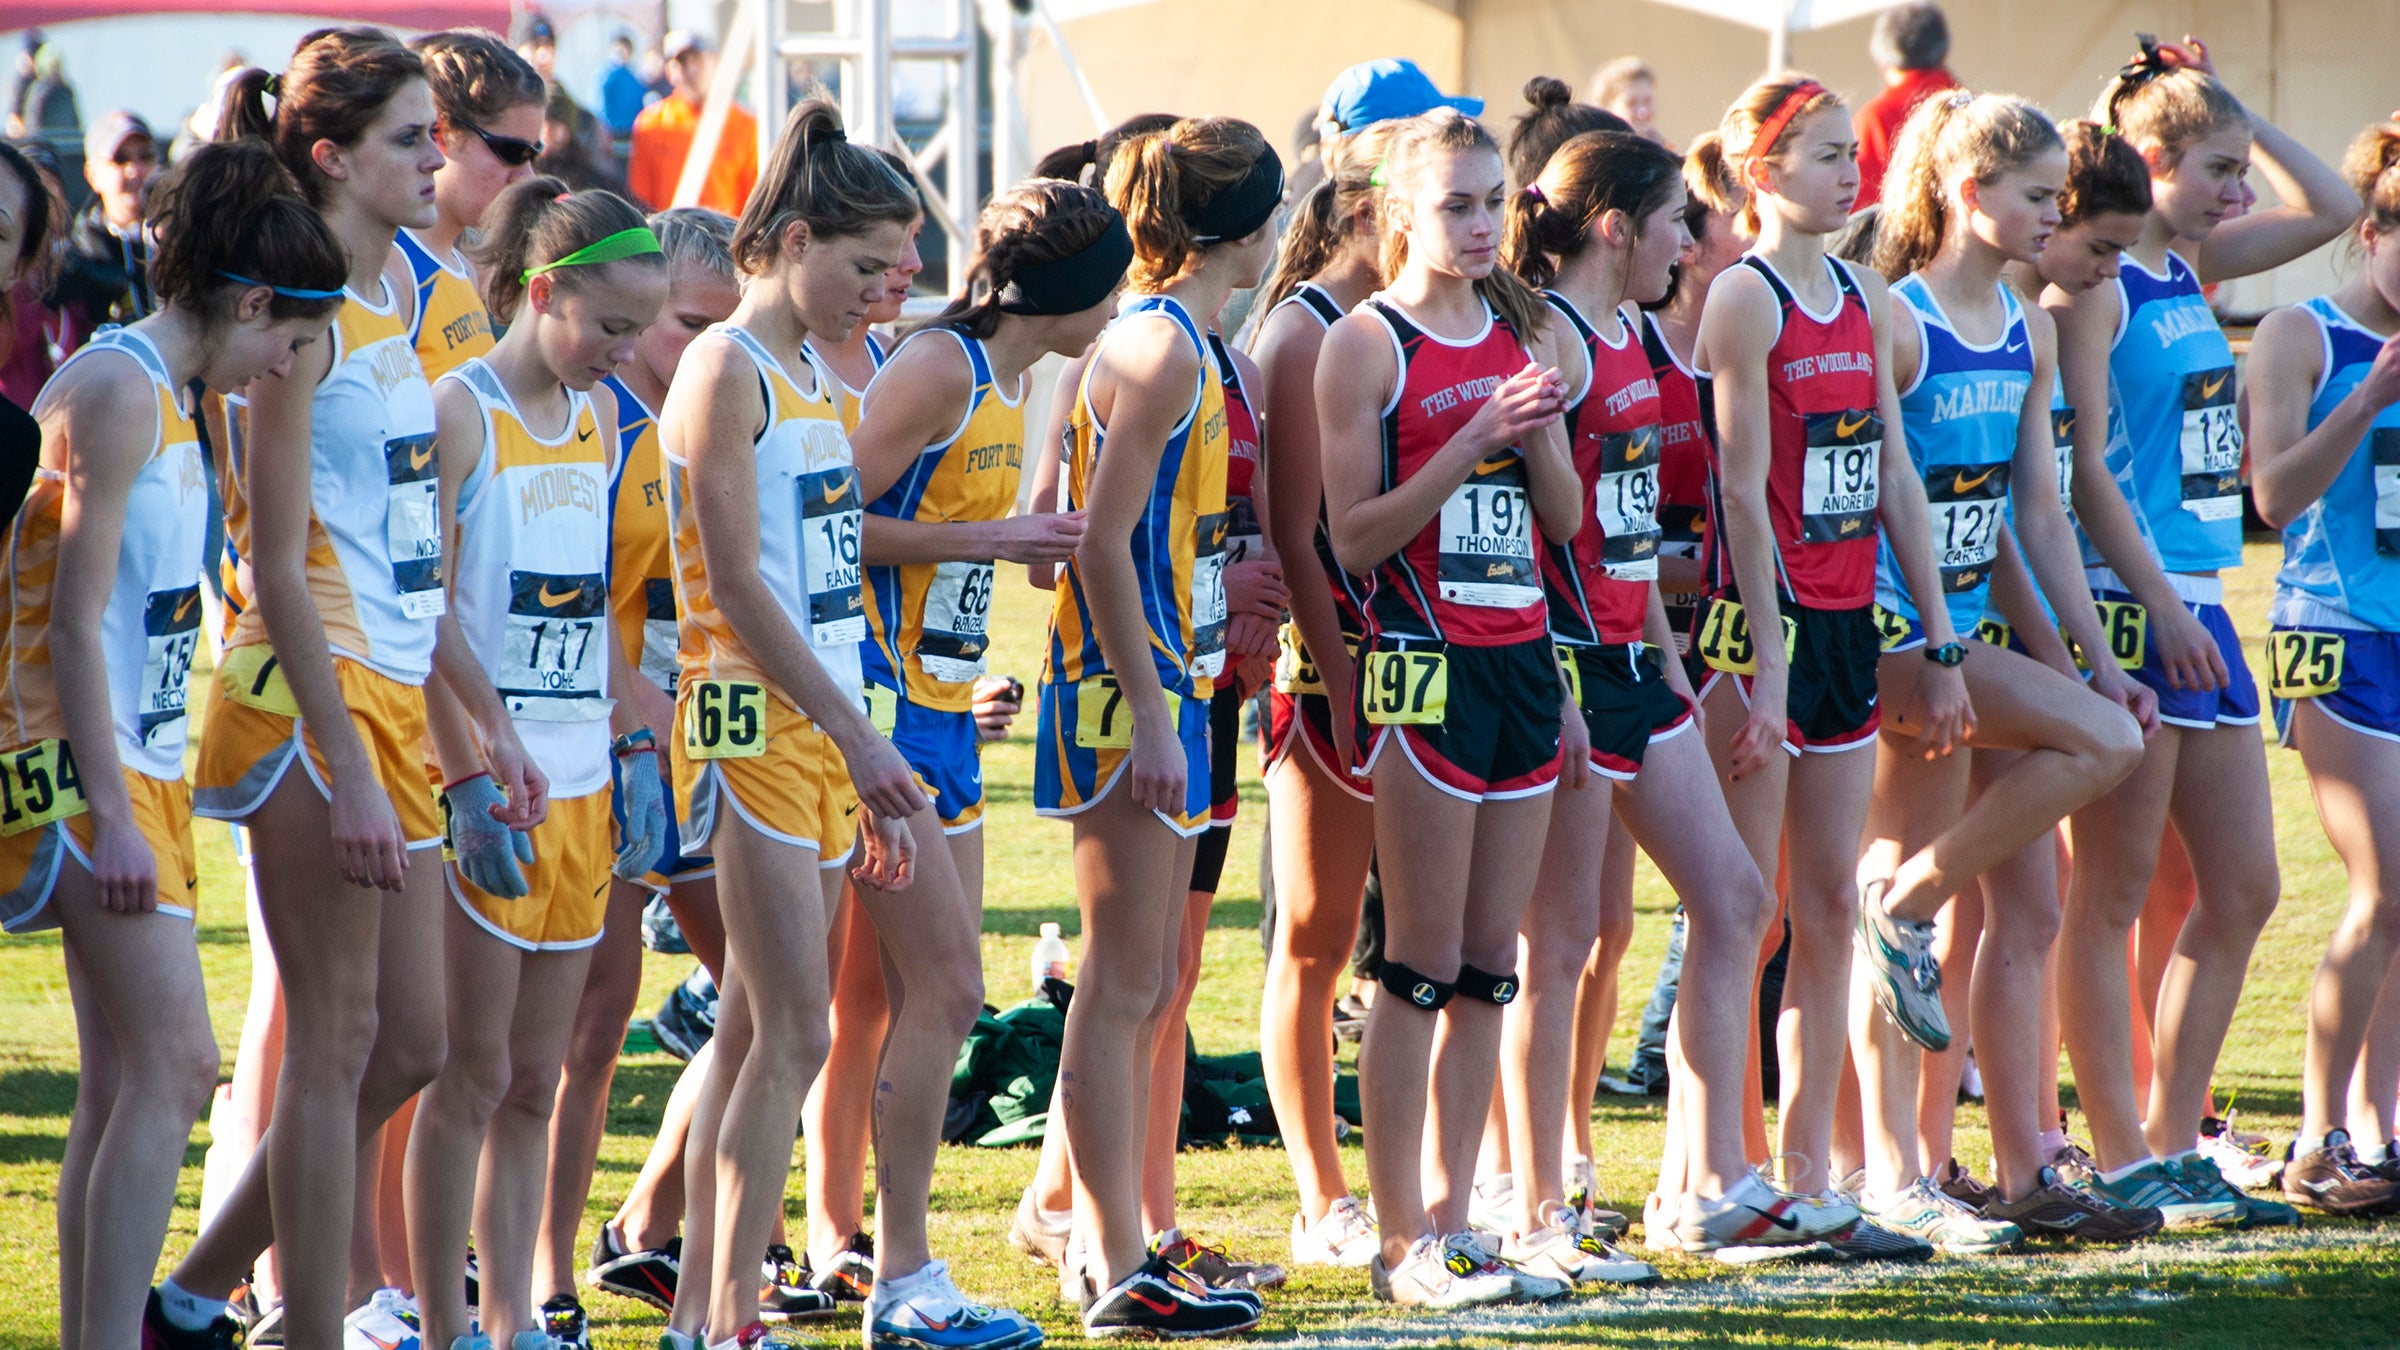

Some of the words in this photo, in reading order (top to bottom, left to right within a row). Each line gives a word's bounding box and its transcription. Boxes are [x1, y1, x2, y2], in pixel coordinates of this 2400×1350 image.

[442, 313, 476, 350] FORT
[1783, 357, 1815, 382] THE
[1421, 387, 1458, 418] THE
[1605, 385, 1632, 416] THE
[966, 443, 1003, 473] FORT
[1825, 447, 1875, 494] 192
[521, 467, 600, 526] MIDWEST
[1464, 488, 1526, 537] 197
[1822, 492, 1874, 512] ANDREWS
[1456, 535, 1529, 556] THOMPSON
[1945, 503, 1997, 550] 121
[1944, 545, 1987, 565] CARTER
[959, 568, 993, 615] 66
[529, 621, 593, 670] 117
[2268, 634, 2339, 688] 125
[1367, 654, 1440, 713] 197
[0, 739, 87, 824] 154
